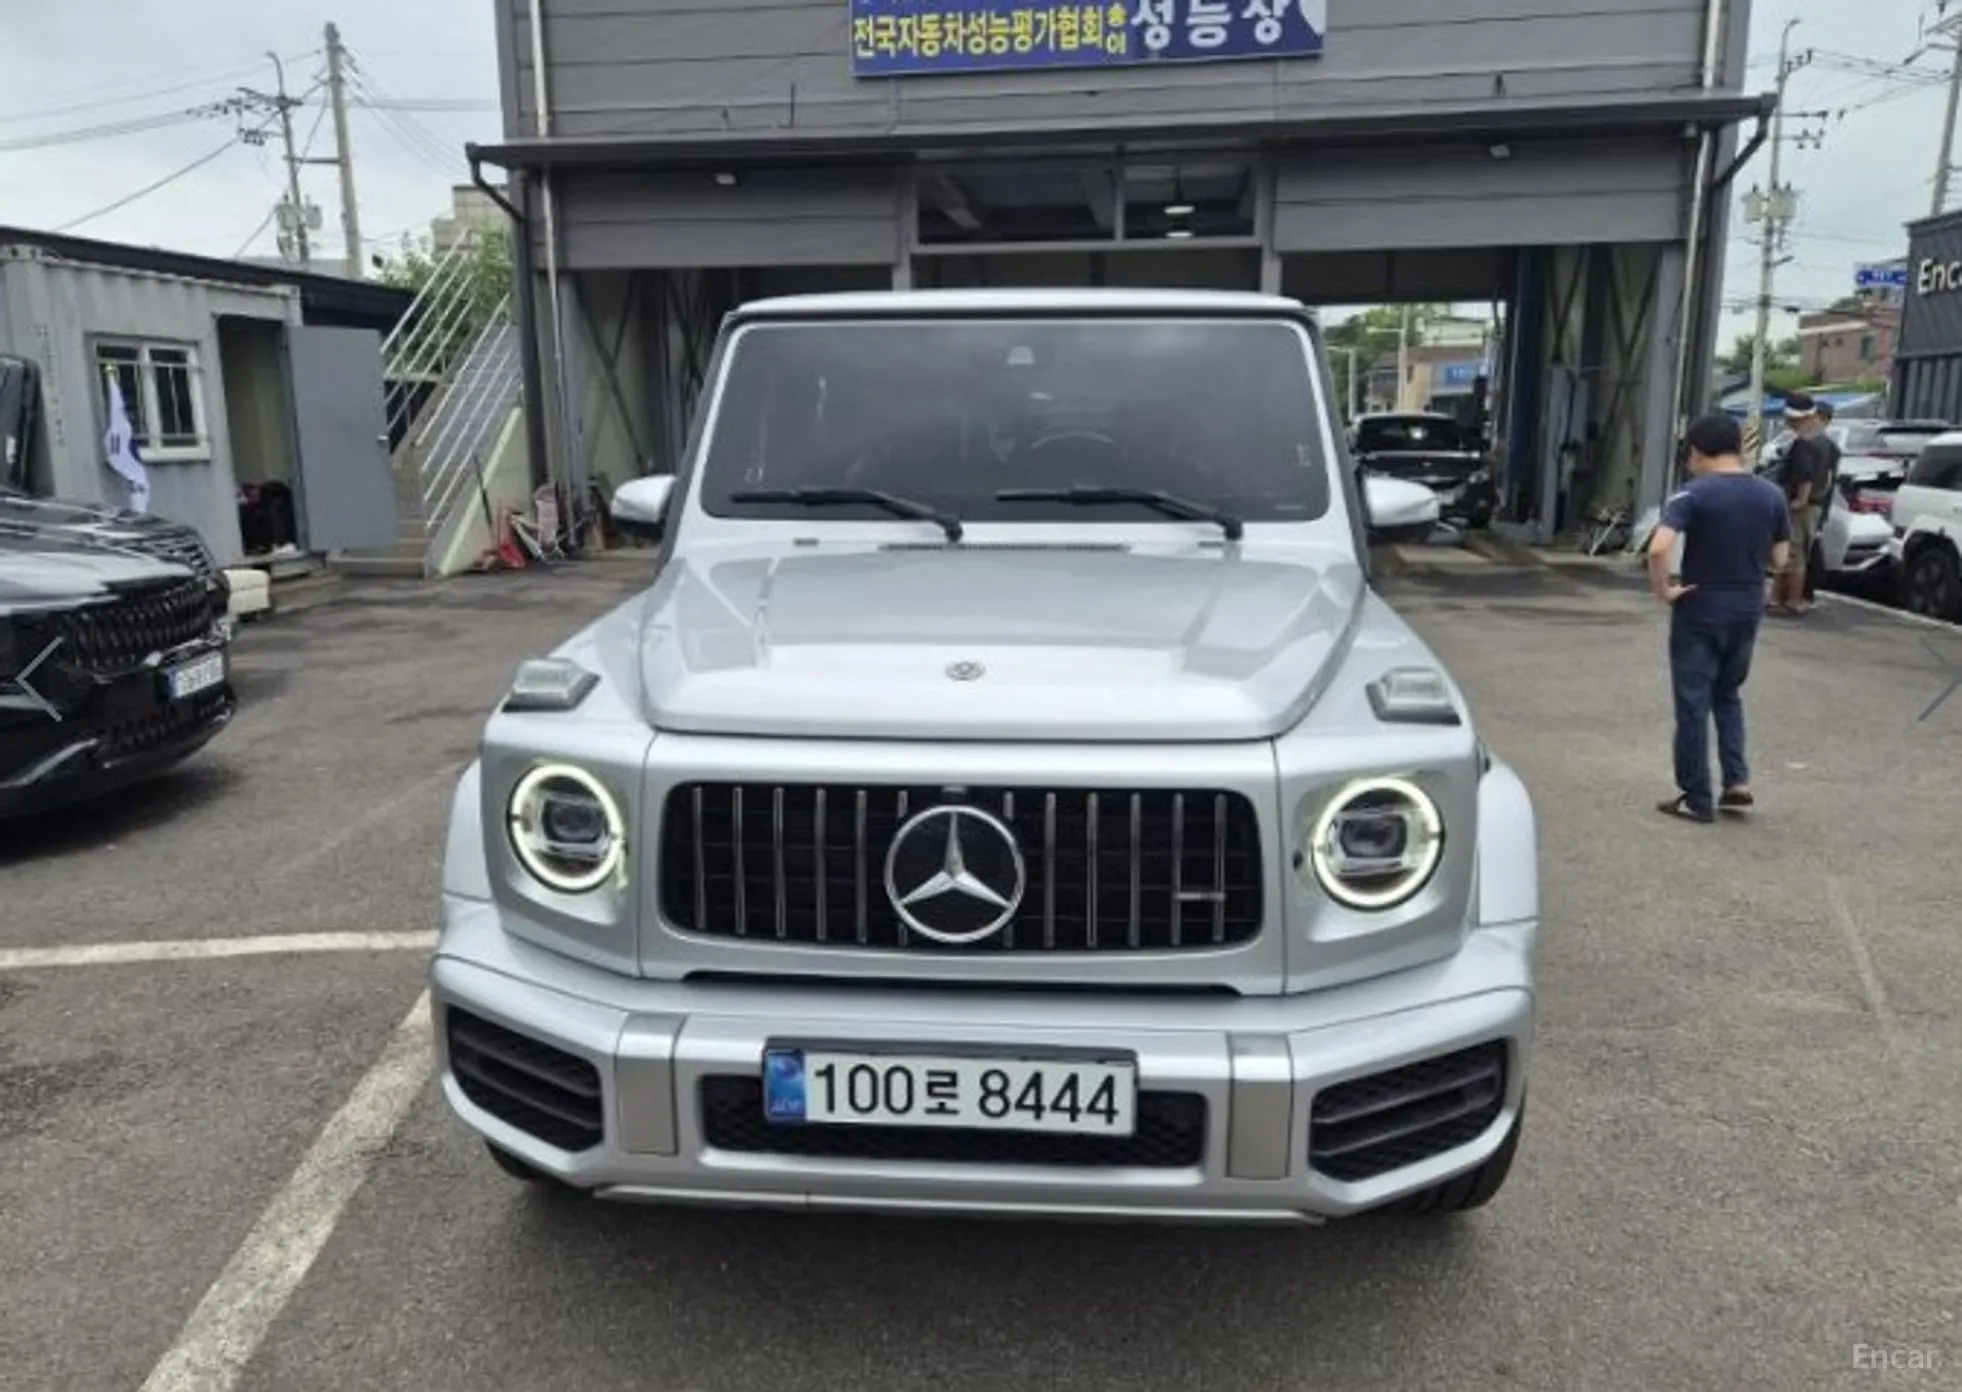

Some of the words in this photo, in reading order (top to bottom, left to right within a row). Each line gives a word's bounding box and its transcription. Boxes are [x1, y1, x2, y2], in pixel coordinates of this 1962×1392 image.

[853, 5, 1103, 59] 전국자동차성능평가협회
[1917, 259, 1962, 294] Enc
[814, 1062, 960, 1115] 100로
[977, 1068, 1120, 1125] 8444
